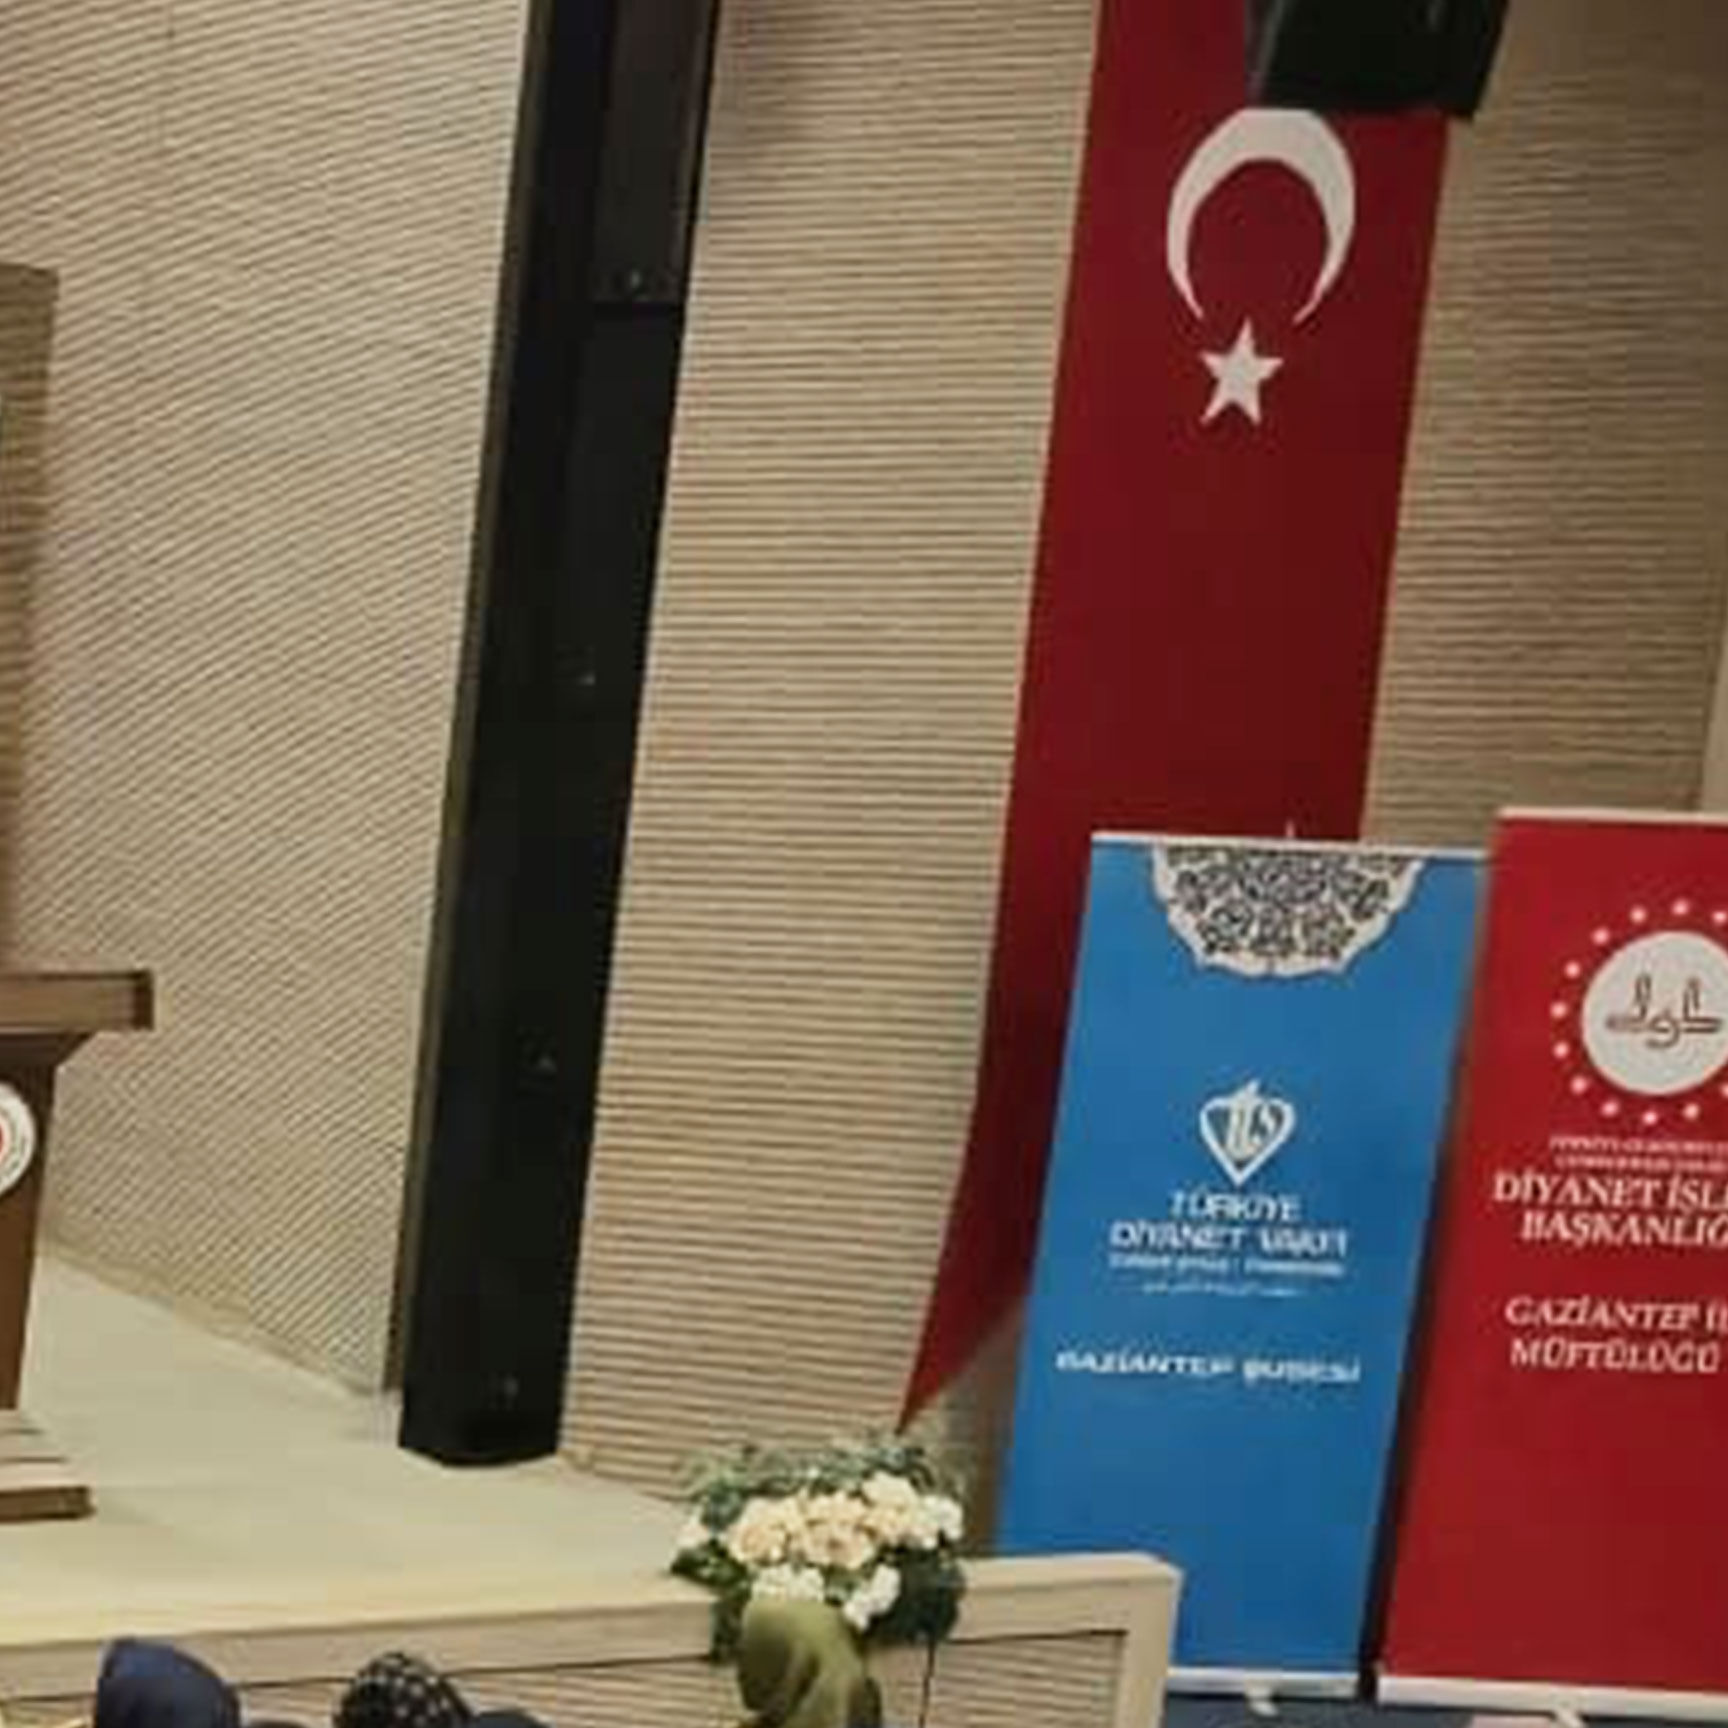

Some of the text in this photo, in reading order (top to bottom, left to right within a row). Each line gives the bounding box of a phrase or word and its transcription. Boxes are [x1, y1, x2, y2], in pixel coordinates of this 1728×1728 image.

[1494, 1168, 1661, 1207] DİYANET
[1505, 1294, 1699, 1332] GAZİANTEP
[1510, 1334, 1720, 1374] MÜFTÜLÜĞÜ
